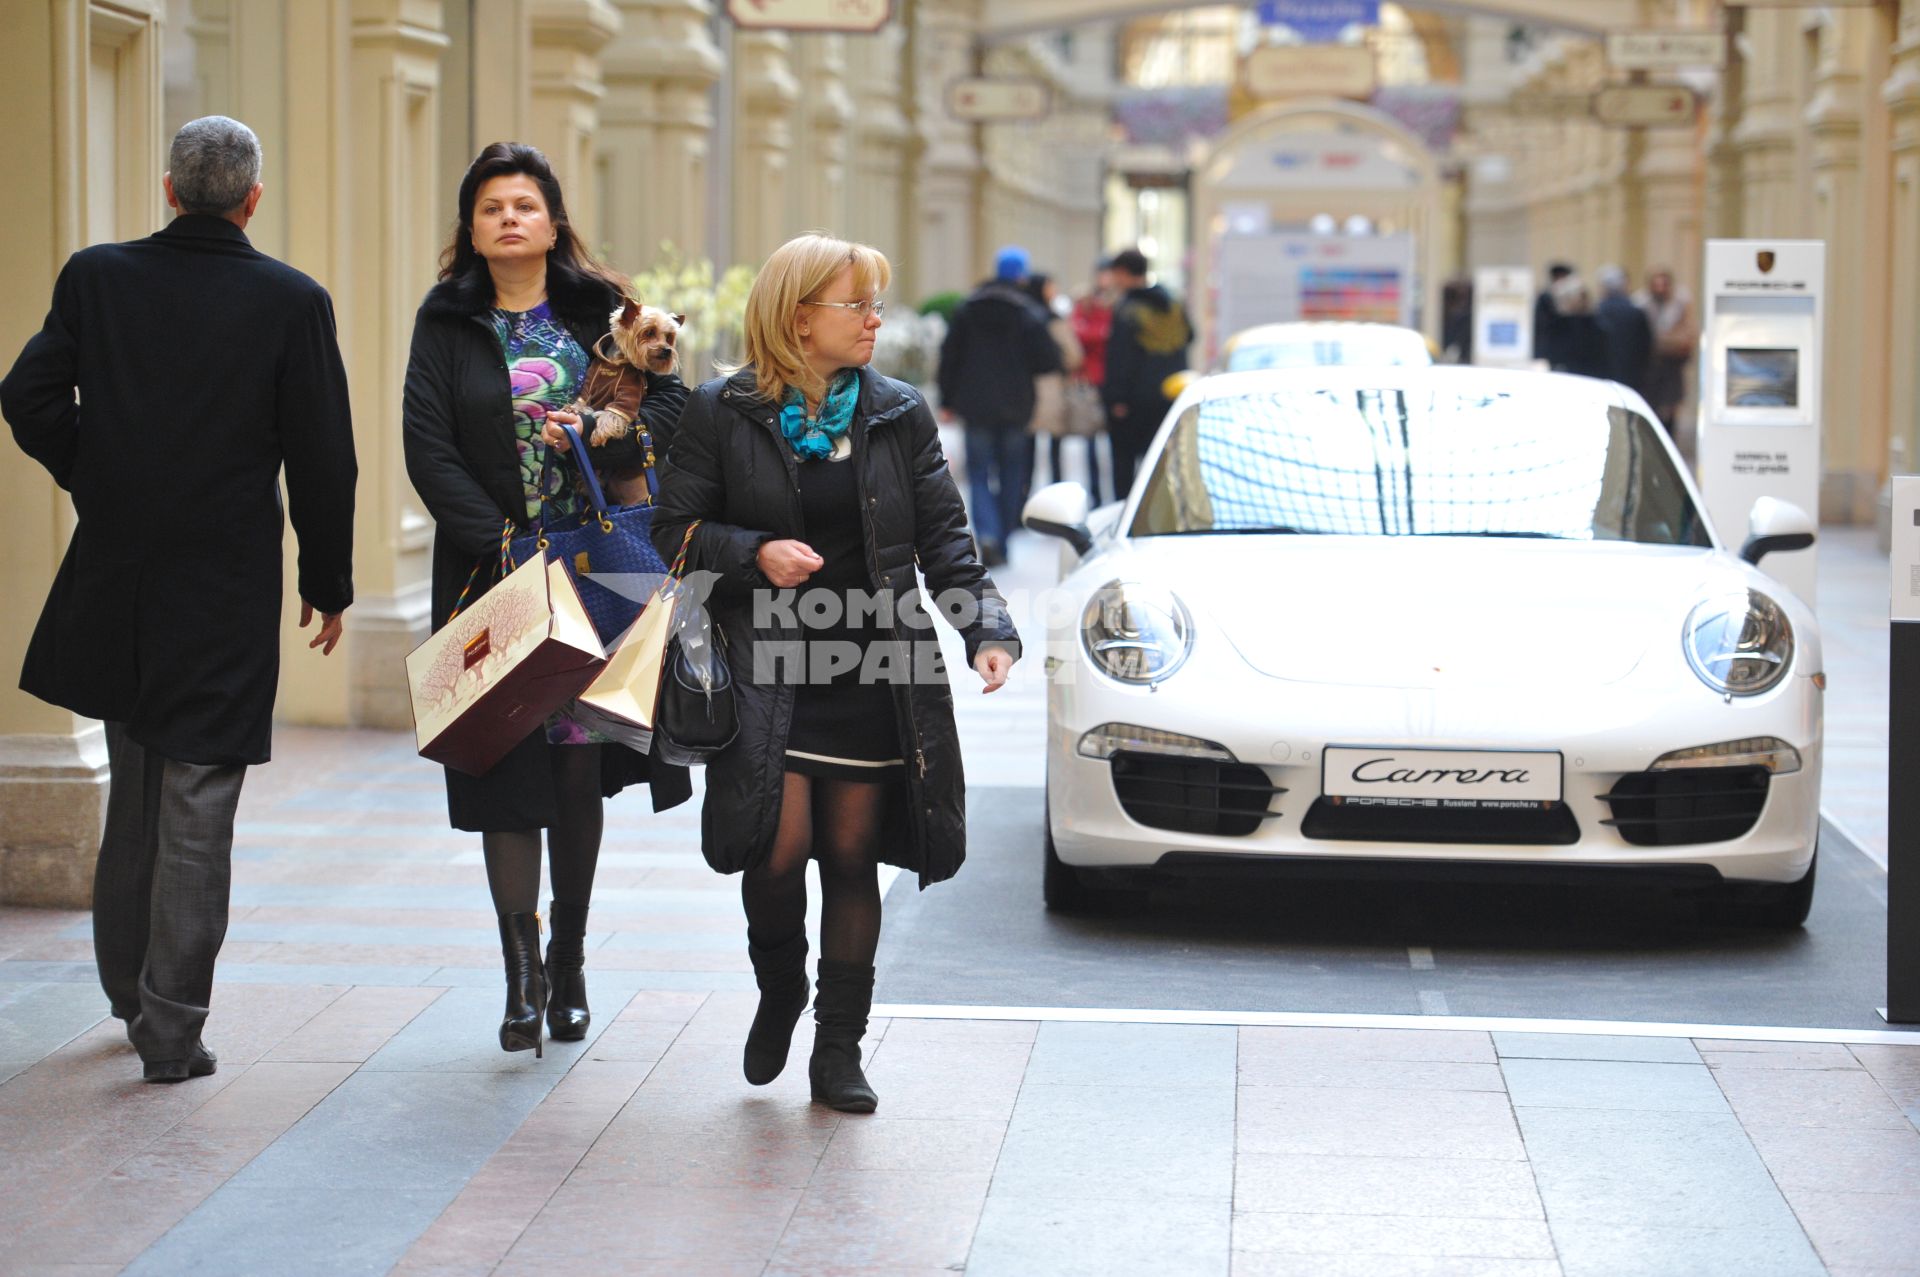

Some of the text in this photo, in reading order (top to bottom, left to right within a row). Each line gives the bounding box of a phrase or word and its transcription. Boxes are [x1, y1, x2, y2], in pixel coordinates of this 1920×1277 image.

[1351, 757, 1531, 785] Carrera
[1346, 796, 1538, 810] PORSCHE Russland www.porsche.ru
